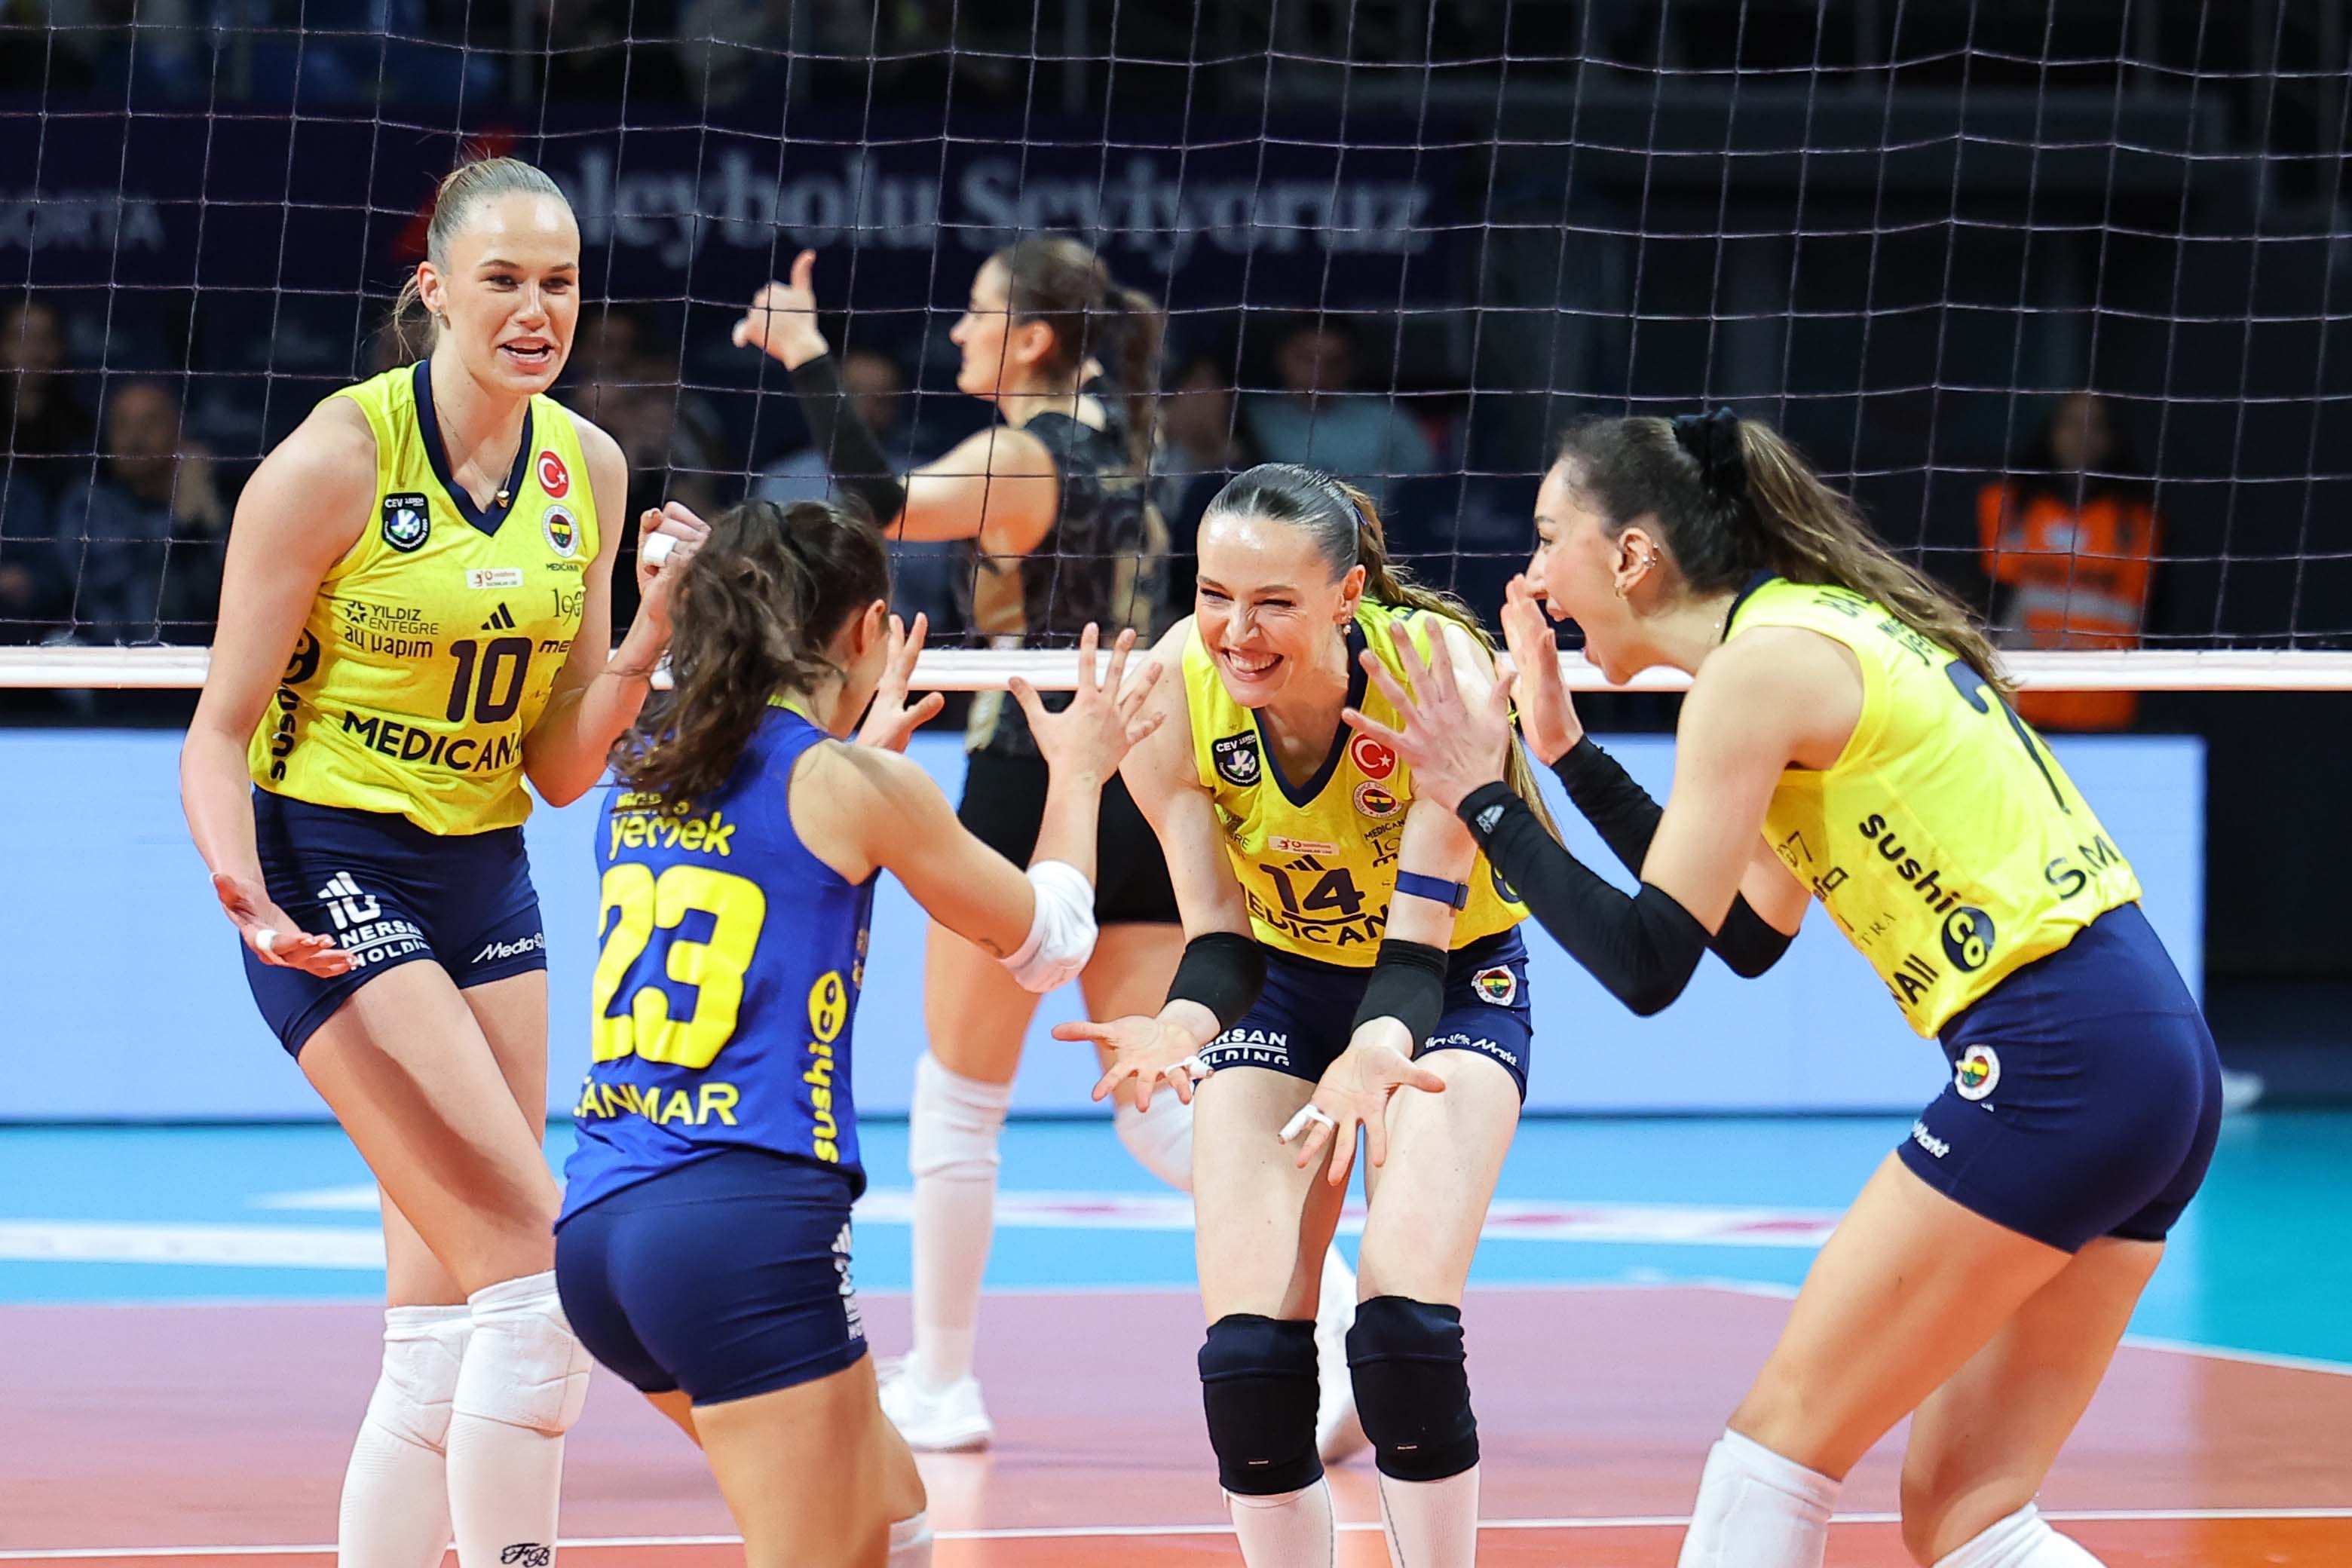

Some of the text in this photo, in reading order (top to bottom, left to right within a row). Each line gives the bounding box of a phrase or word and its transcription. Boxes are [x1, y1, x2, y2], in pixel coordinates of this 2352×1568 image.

[562, 149, 941, 268] leybolu
[369, 620, 439, 635] ENTEGRE
[372, 604, 421, 622] YILDIZ
[345, 626, 364, 650] ay
[446, 637, 533, 724] 10
[342, 711, 522, 773] MEDICAN
[1216, 740, 1237, 752] CEV
[608, 811, 736, 861] yemek
[1364, 819, 1406, 841] MEDICAN
[1259, 864, 1365, 914] 14
[339, 920, 424, 948] NERSA
[471, 937, 535, 964] Media
[593, 863, 767, 1069] 23
[572, 1076, 740, 1125] ANMAR
